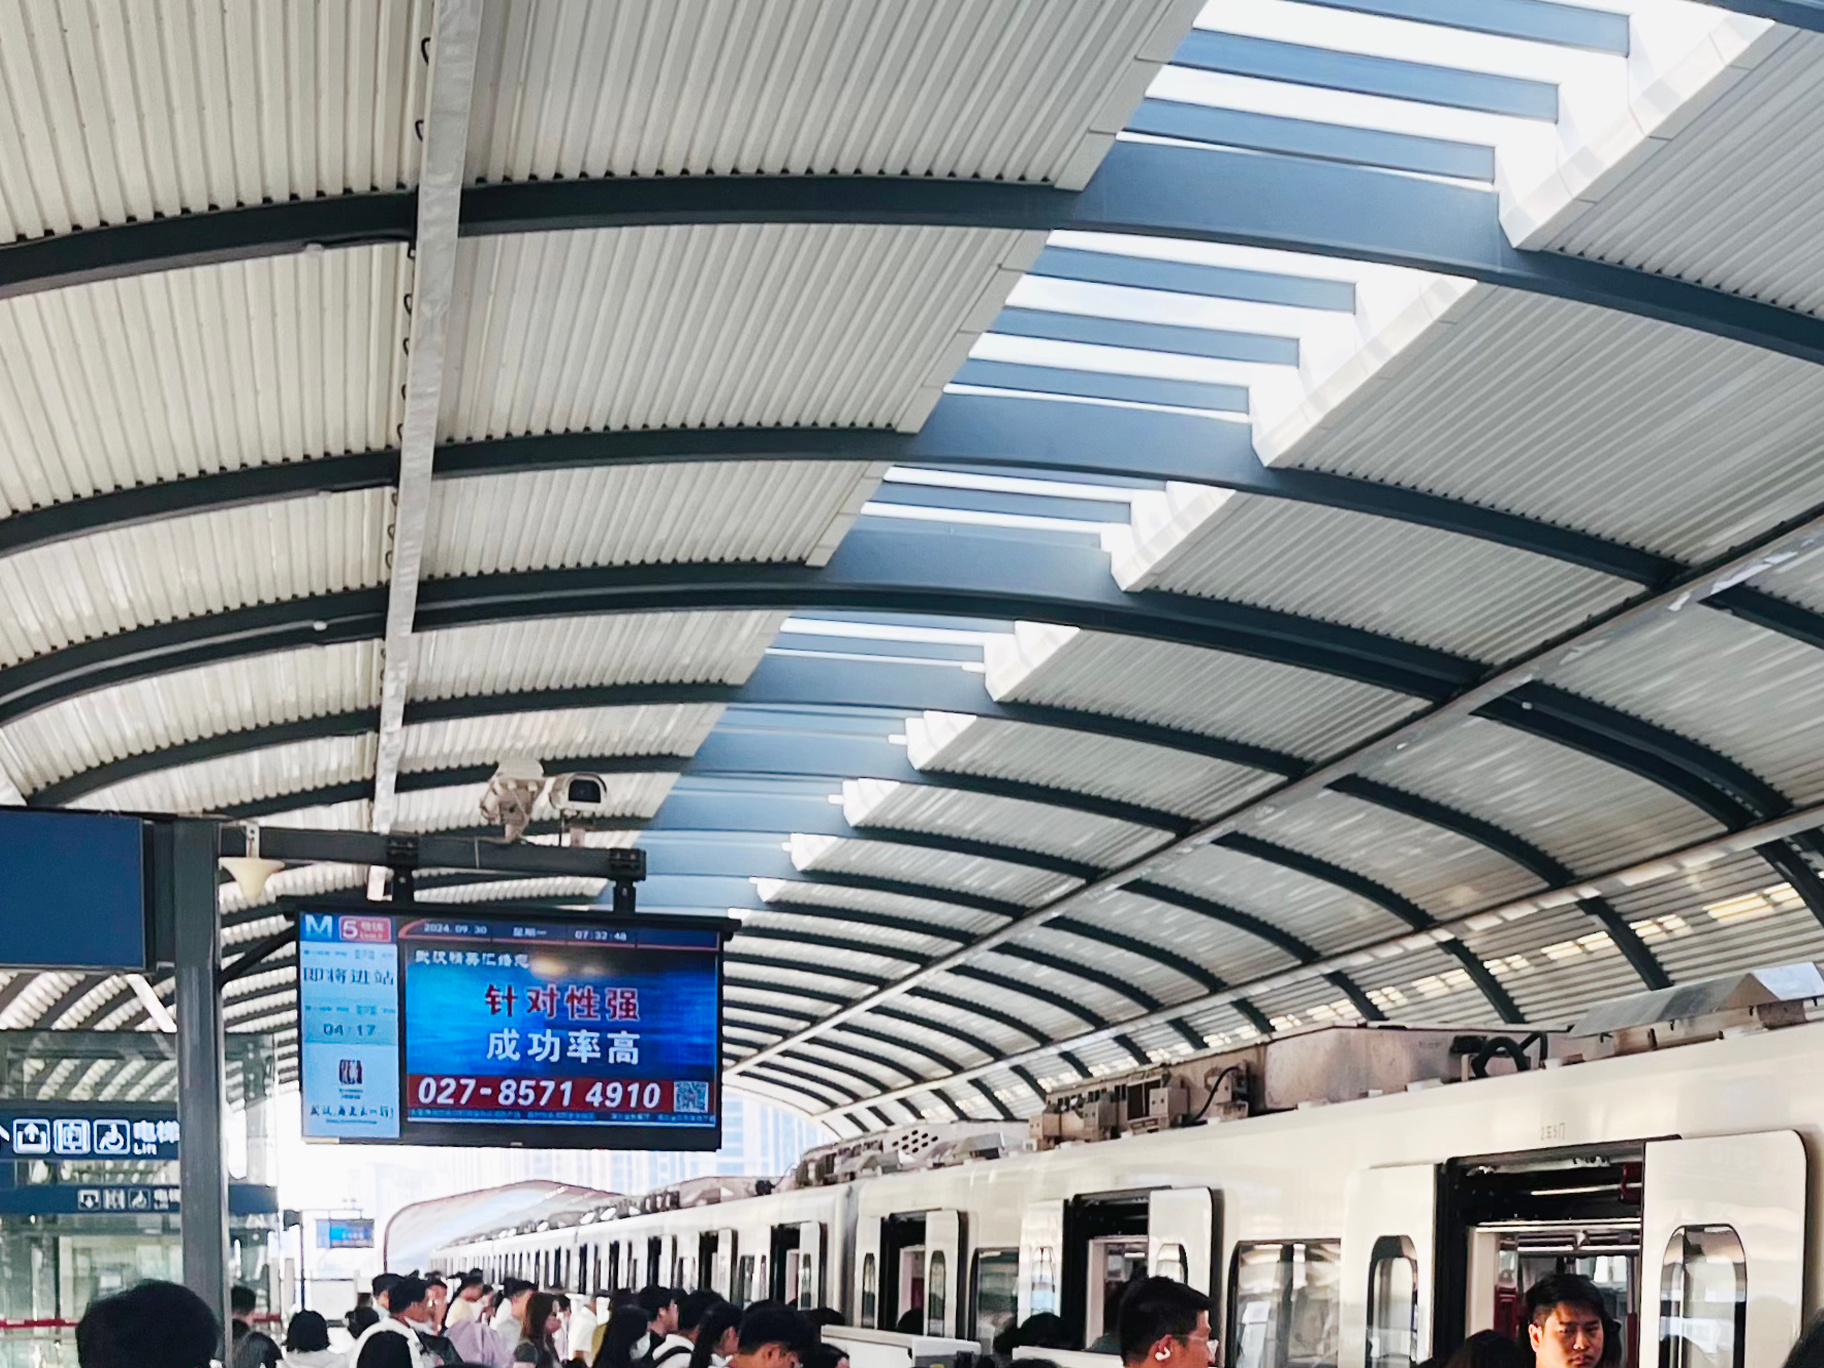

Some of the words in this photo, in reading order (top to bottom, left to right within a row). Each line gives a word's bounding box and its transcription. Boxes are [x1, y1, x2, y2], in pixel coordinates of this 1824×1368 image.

[485, 984, 641, 1021] 针对性强
[486, 1028, 641, 1065] 成功率高
[418, 1077, 573, 1107] 027-8571
[585, 1081, 661, 1109] 4910
